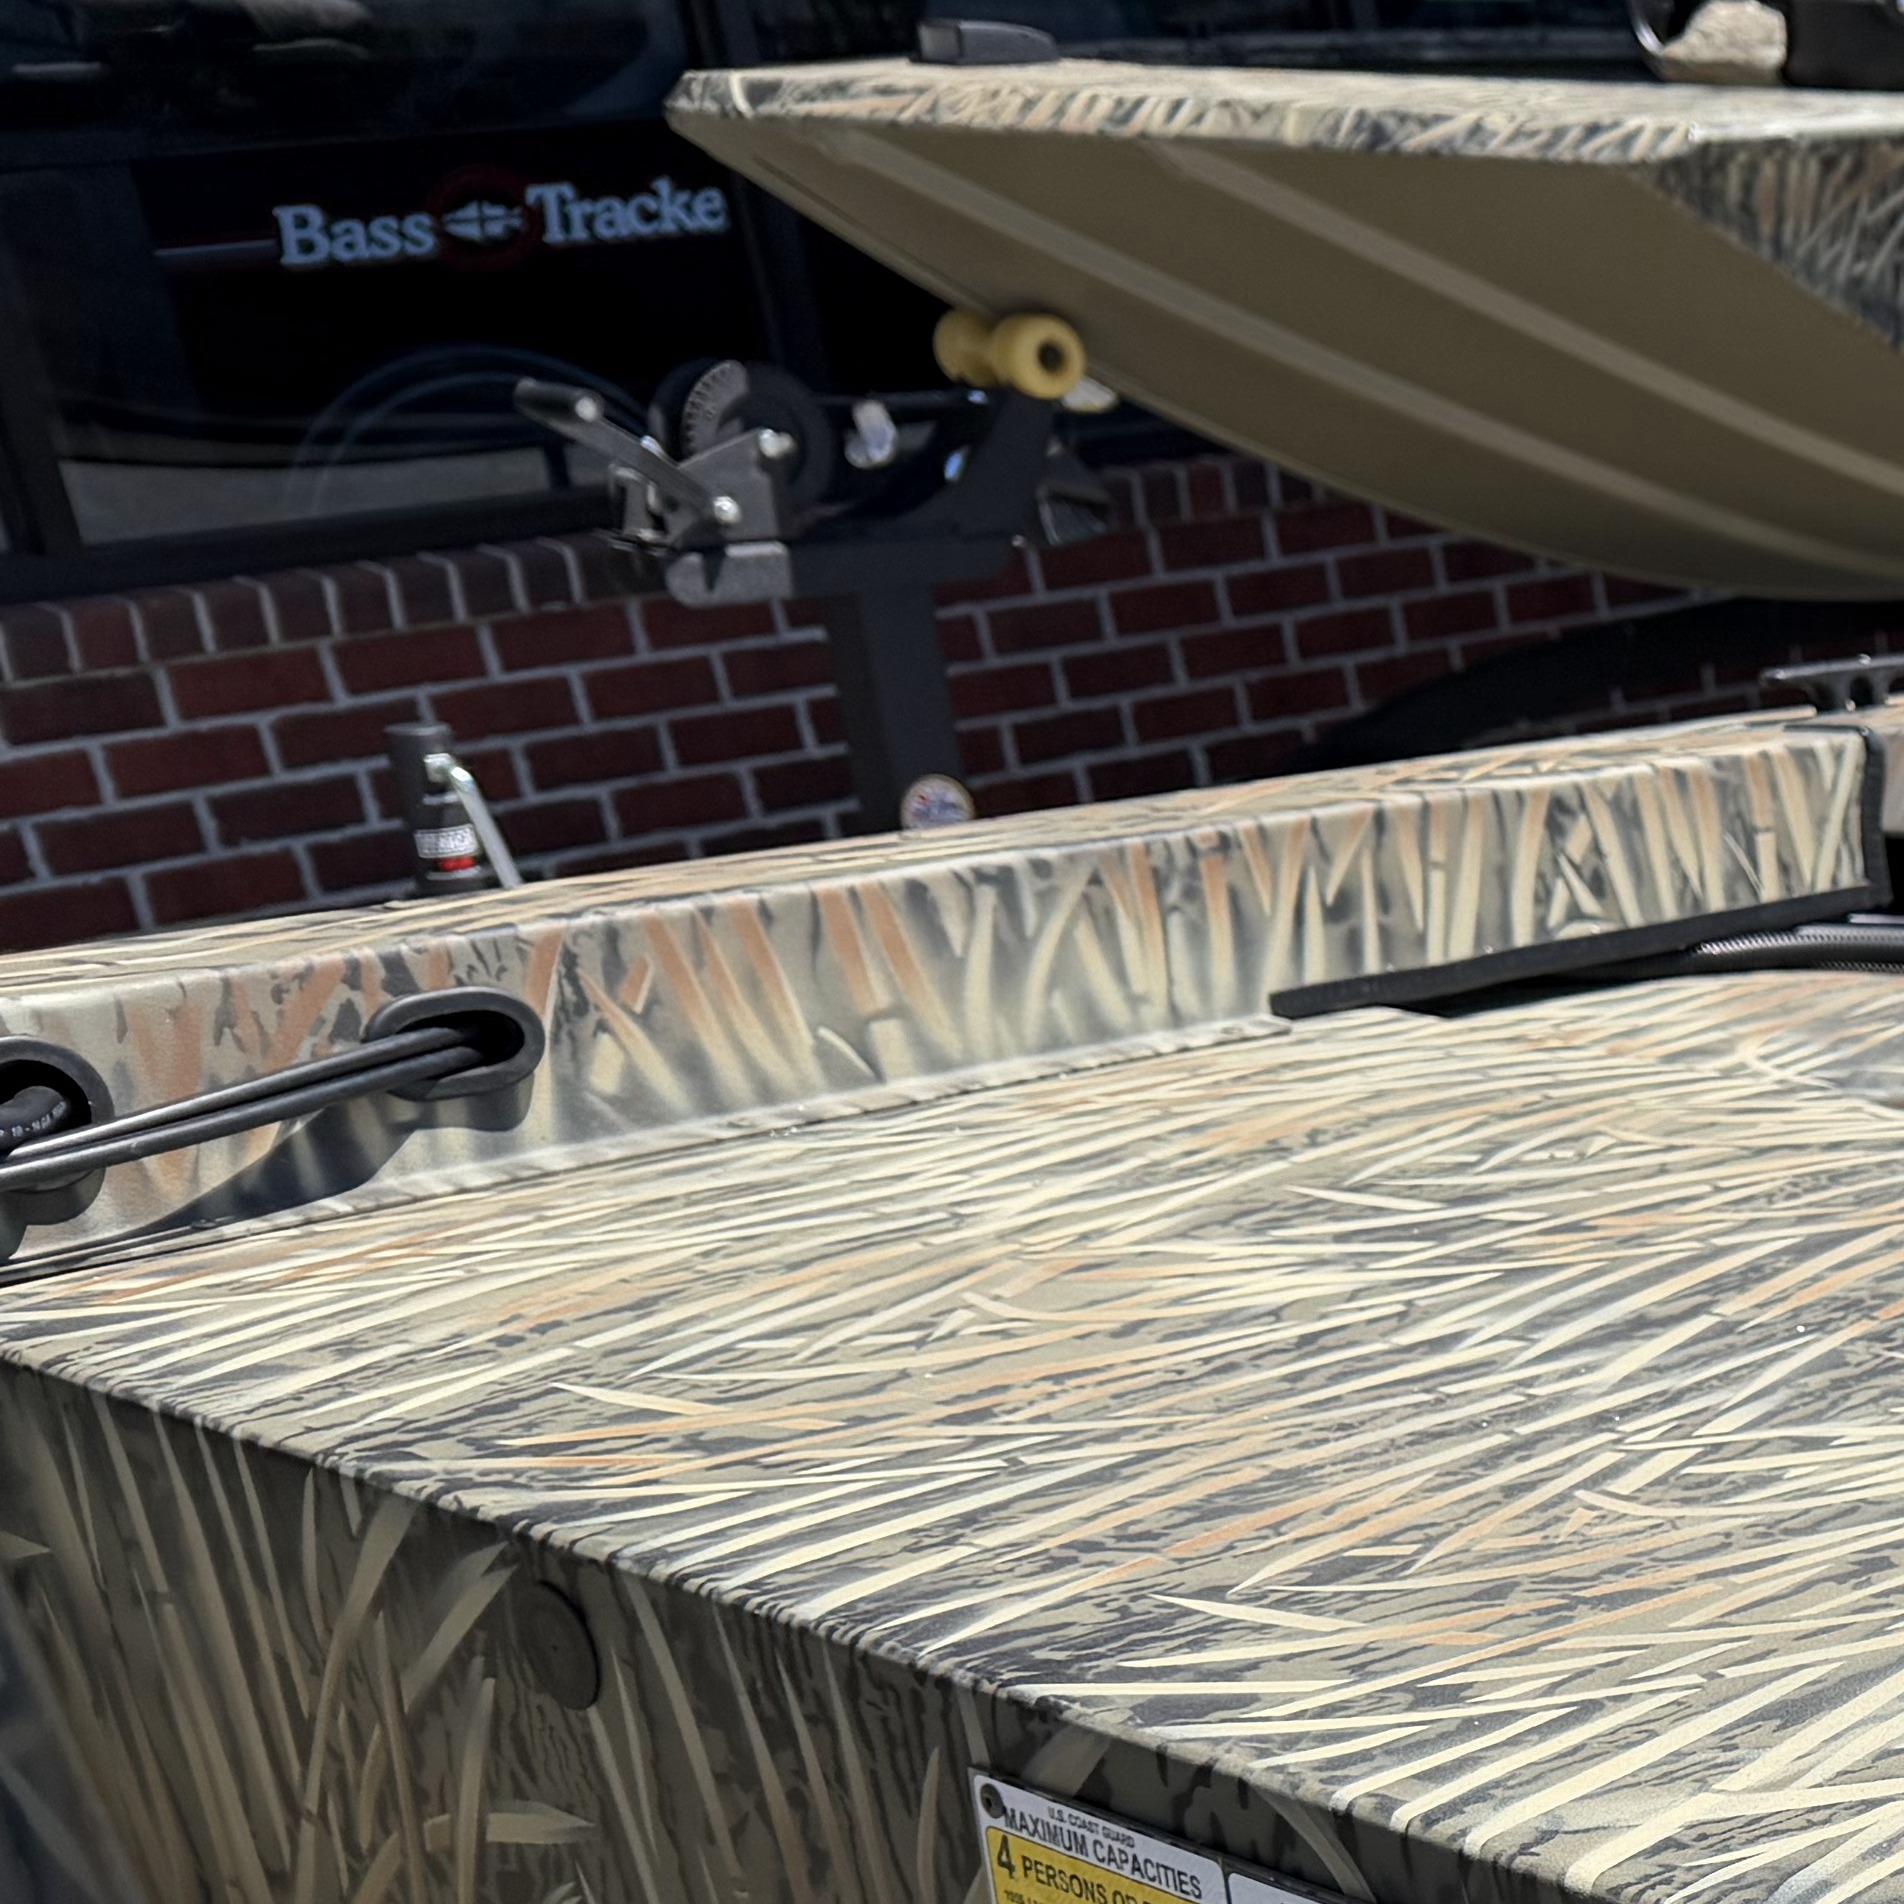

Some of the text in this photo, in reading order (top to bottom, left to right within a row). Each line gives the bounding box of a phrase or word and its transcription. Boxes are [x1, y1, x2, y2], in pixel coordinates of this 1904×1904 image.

[273, 203, 437, 266] Bass
[1002, 1806, 1203, 1900] MAXIMUM CAPACITIES
[1047, 1806, 1136, 1849] U.S. COAST GUARD
[996, 1834, 1016, 1880] 4
